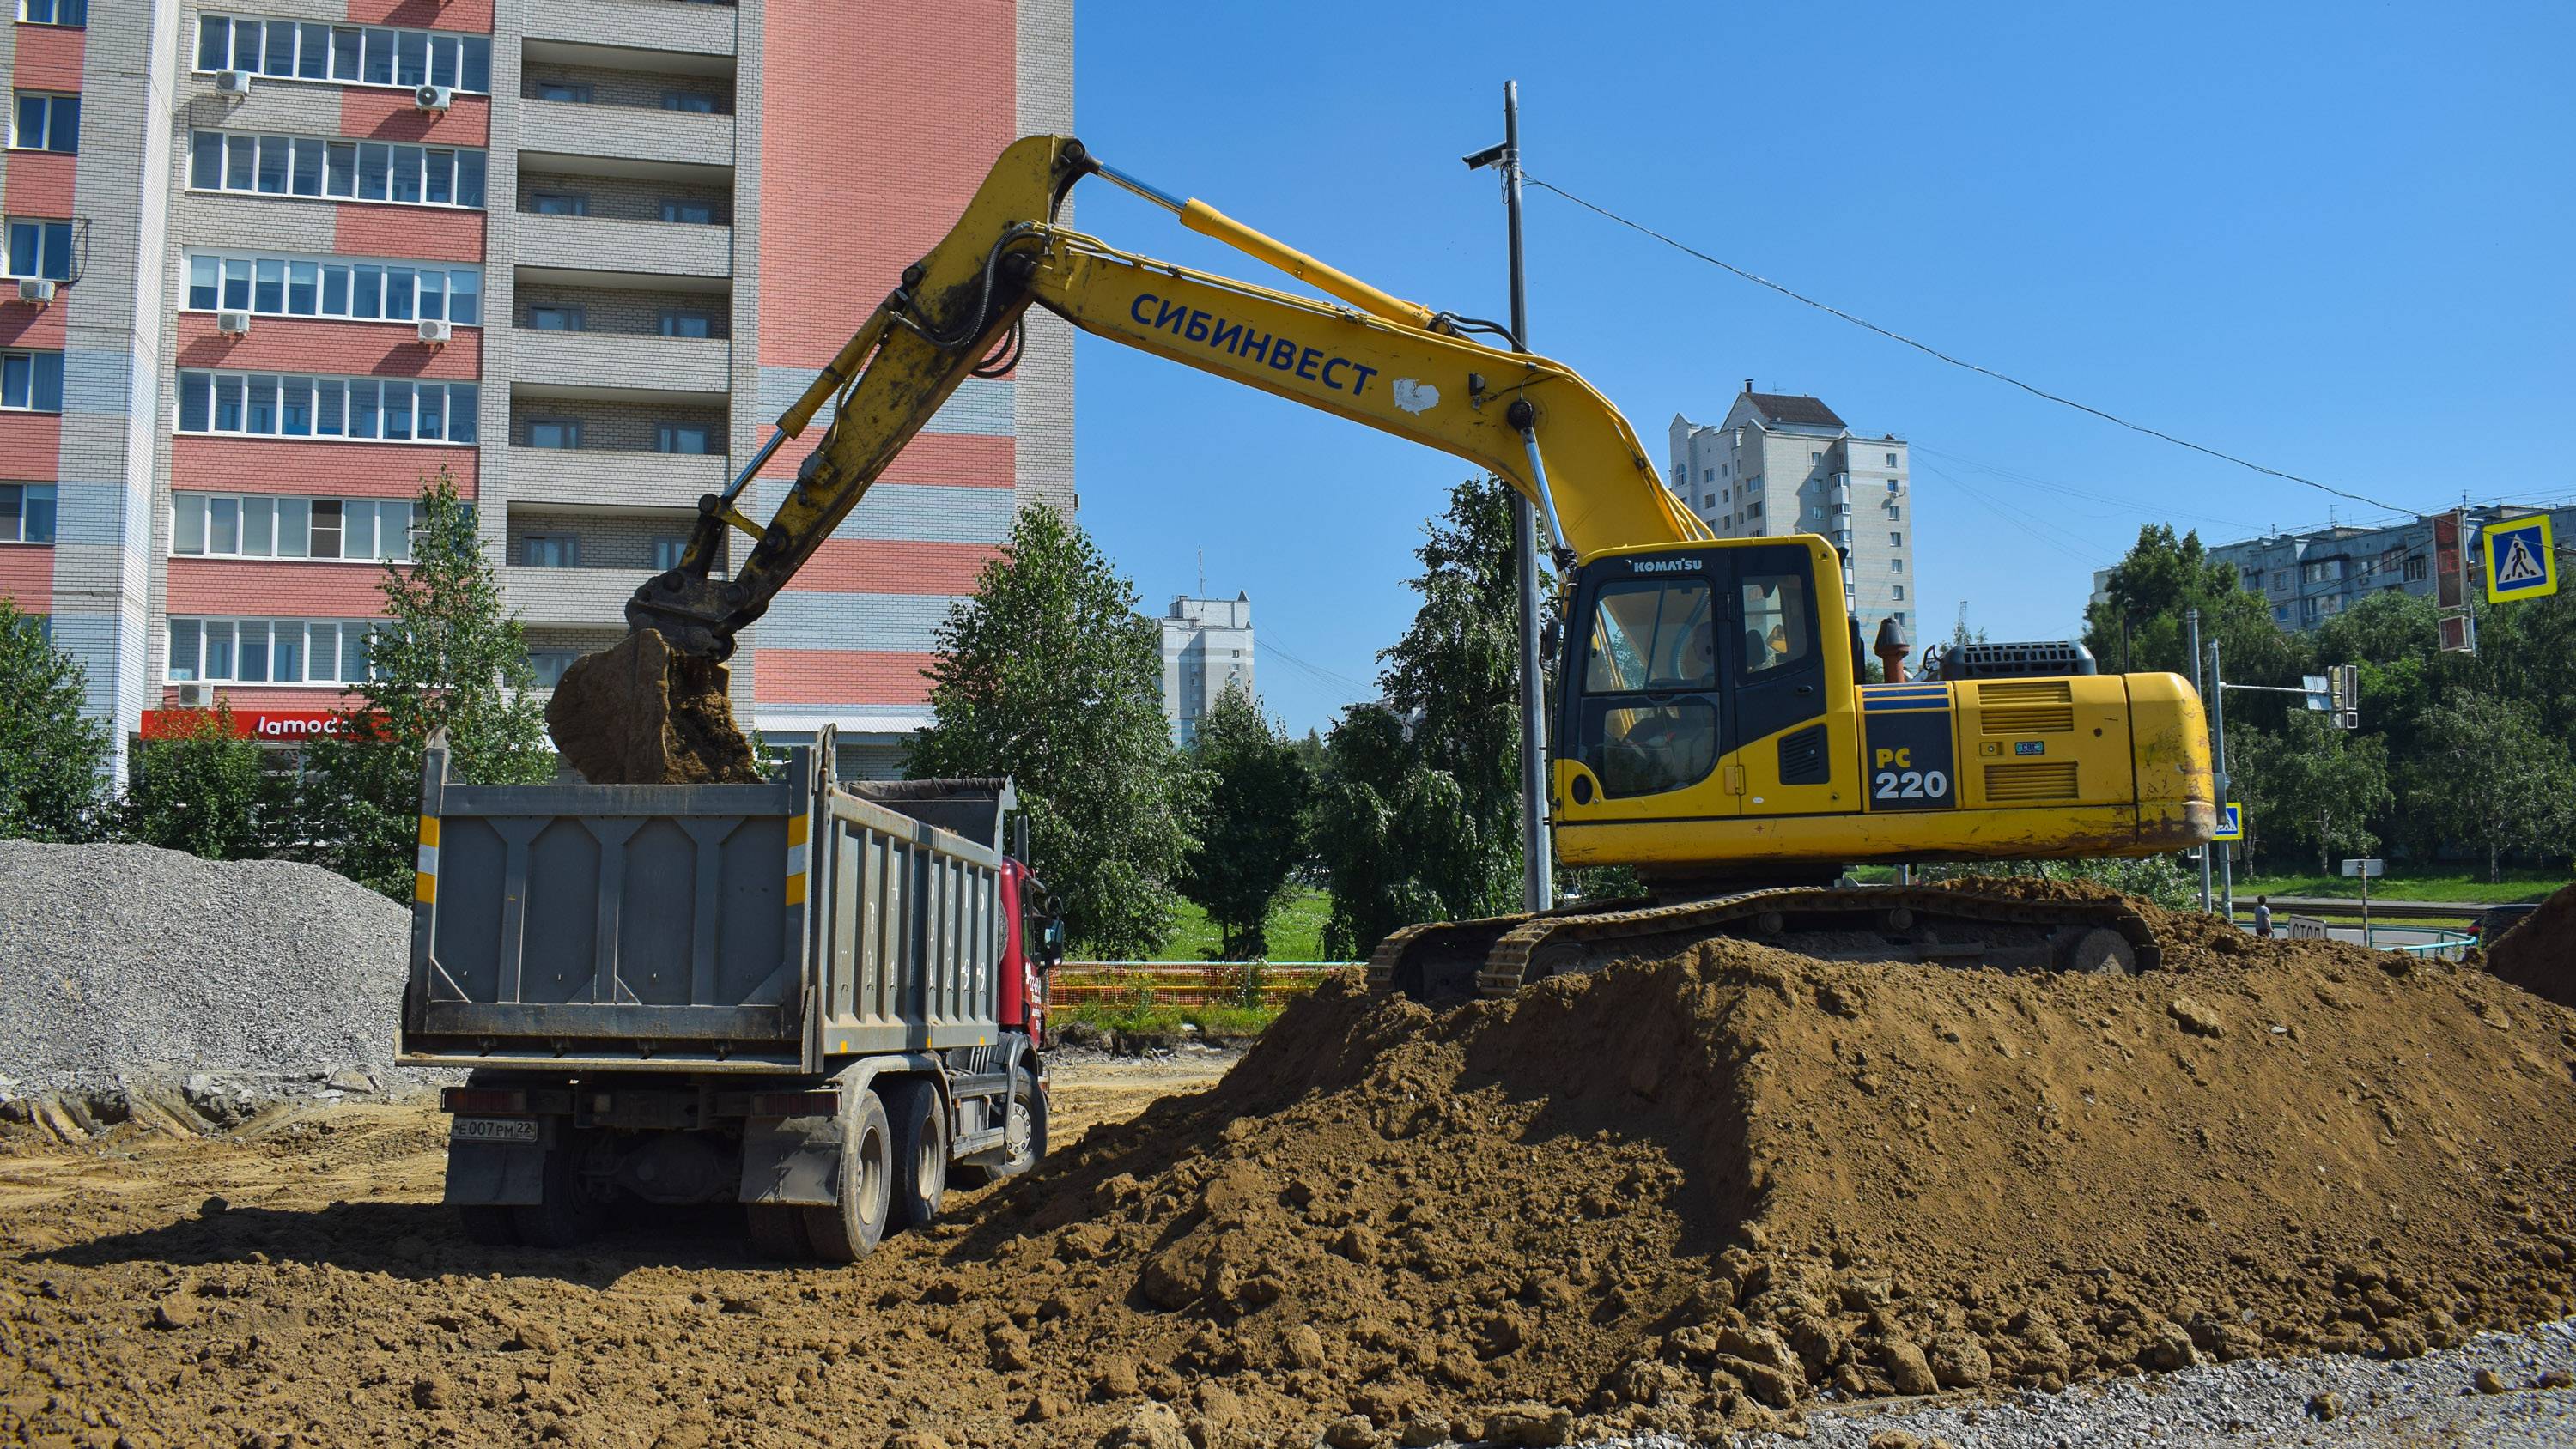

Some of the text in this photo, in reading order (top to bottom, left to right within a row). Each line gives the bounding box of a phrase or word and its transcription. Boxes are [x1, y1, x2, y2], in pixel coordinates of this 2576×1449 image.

[1131, 294, 1378, 396] СИБИНВЕСТ
[1634, 558, 1703, 573] KOMATSU
[1876, 748, 1911, 769] PC
[1875, 771, 1947, 799] 220
